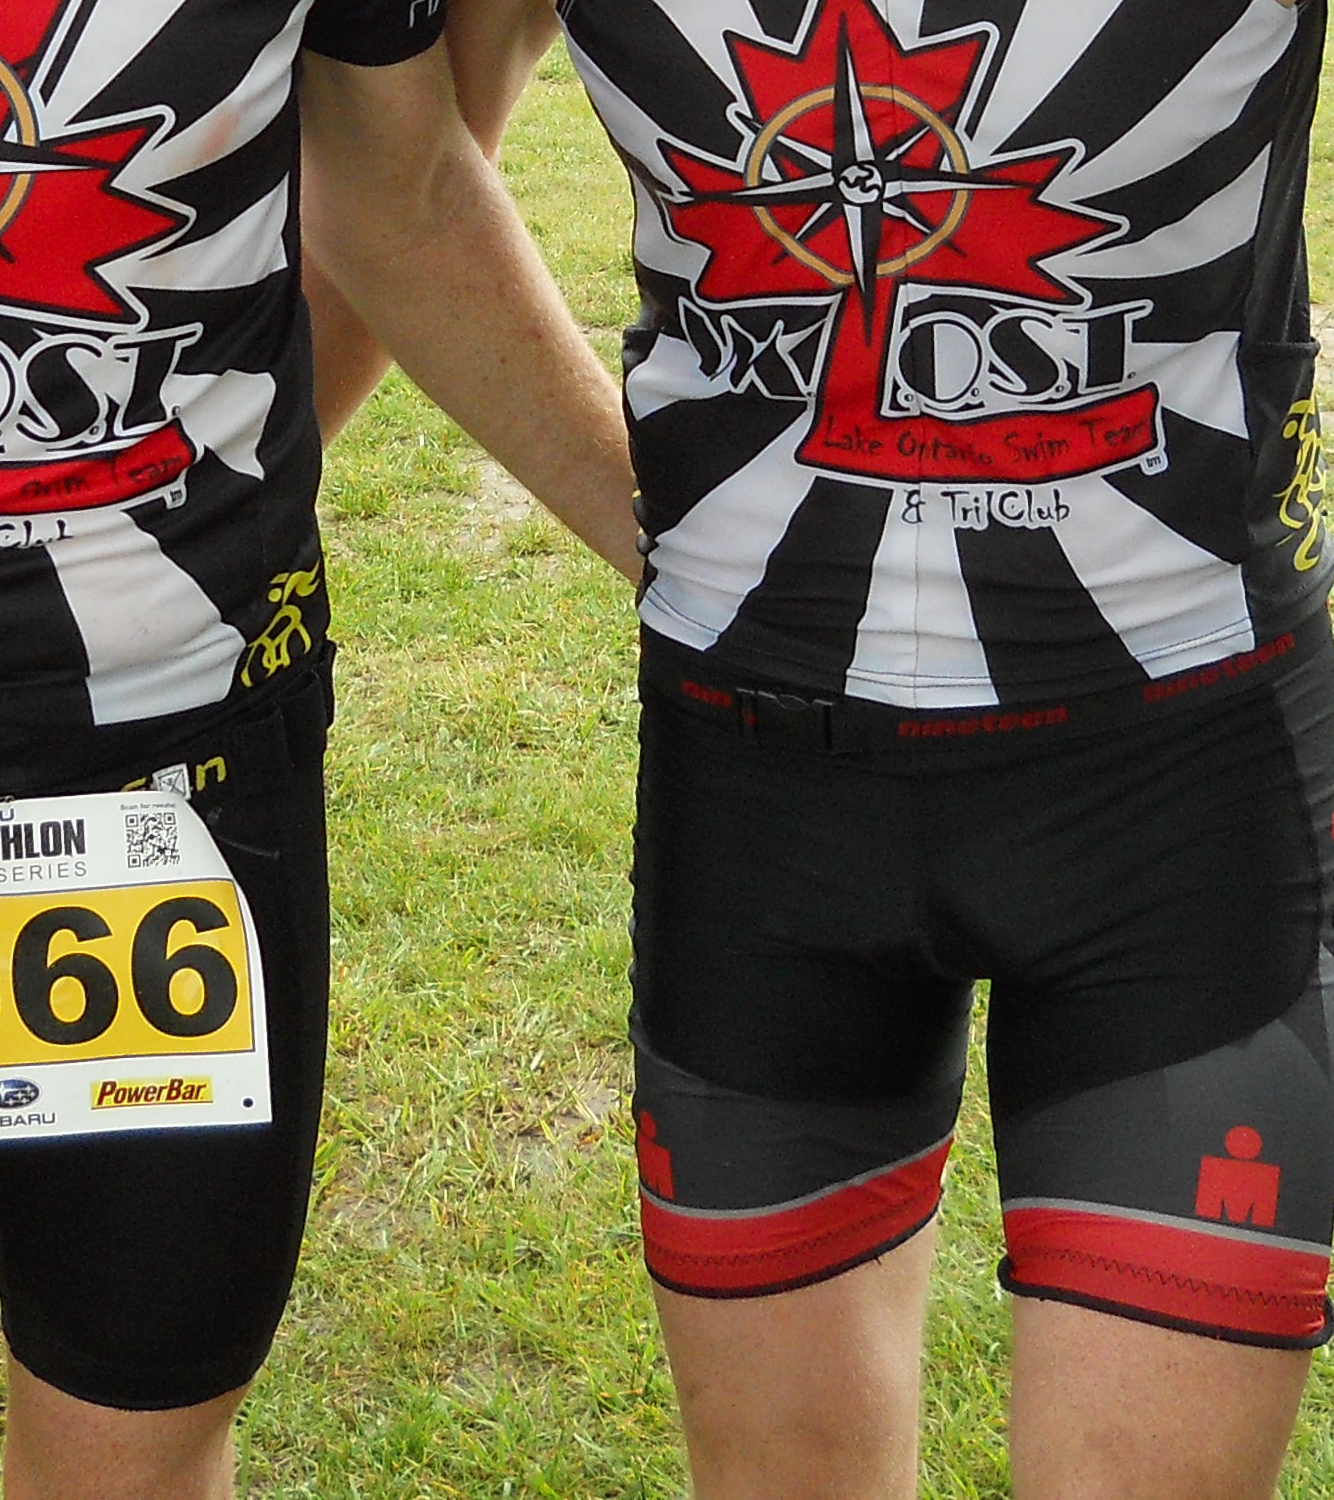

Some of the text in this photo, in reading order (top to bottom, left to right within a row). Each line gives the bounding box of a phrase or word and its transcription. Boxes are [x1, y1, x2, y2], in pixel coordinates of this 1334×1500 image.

[824, 415, 1148, 466] Lake Ontario Swim Team
[900, 489, 1071, 525] & Tri Club
[98, 1078, 207, 1107] PowerBar
